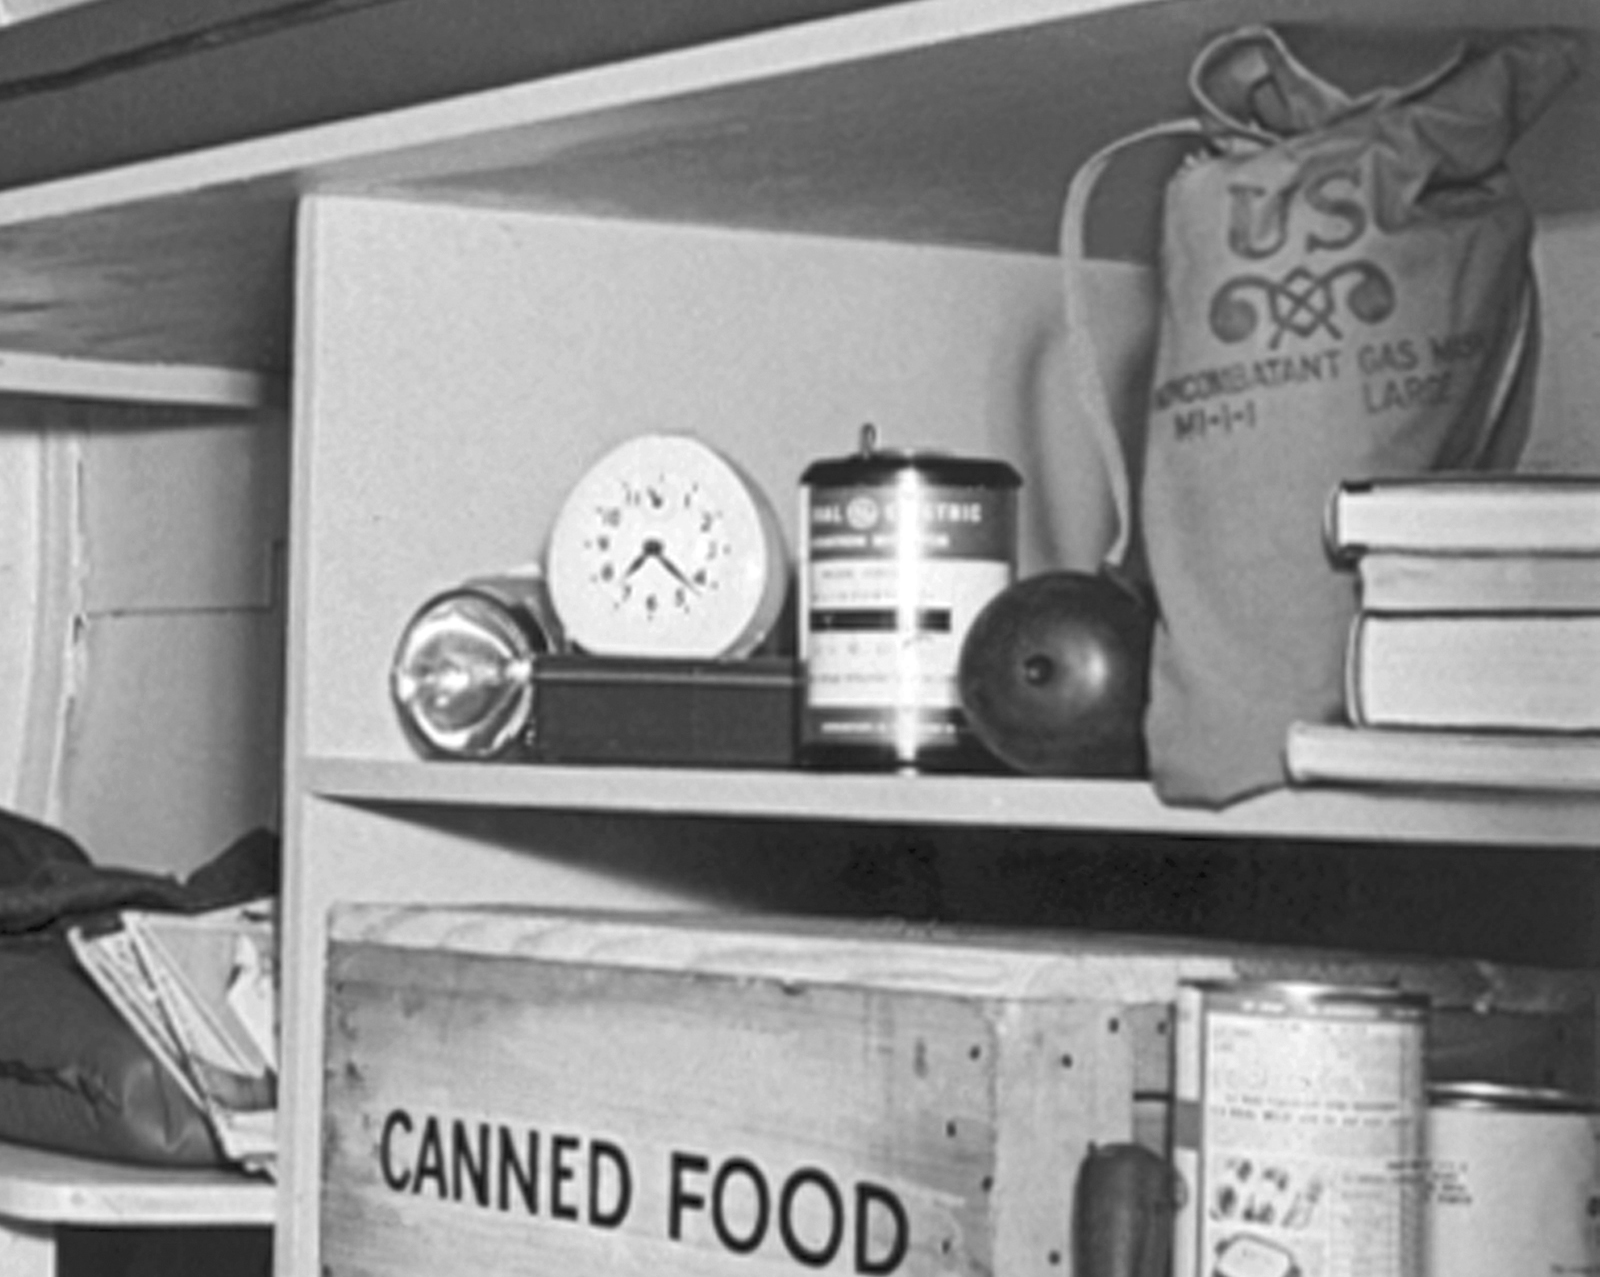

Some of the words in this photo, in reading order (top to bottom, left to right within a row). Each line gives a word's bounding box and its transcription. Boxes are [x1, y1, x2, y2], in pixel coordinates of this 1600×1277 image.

[1227, 170, 1368, 261] US
[1356, 338, 1419, 375] GAS
[379, 1107, 632, 1230] CANNED
[668, 1149, 911, 1277] FOOD
